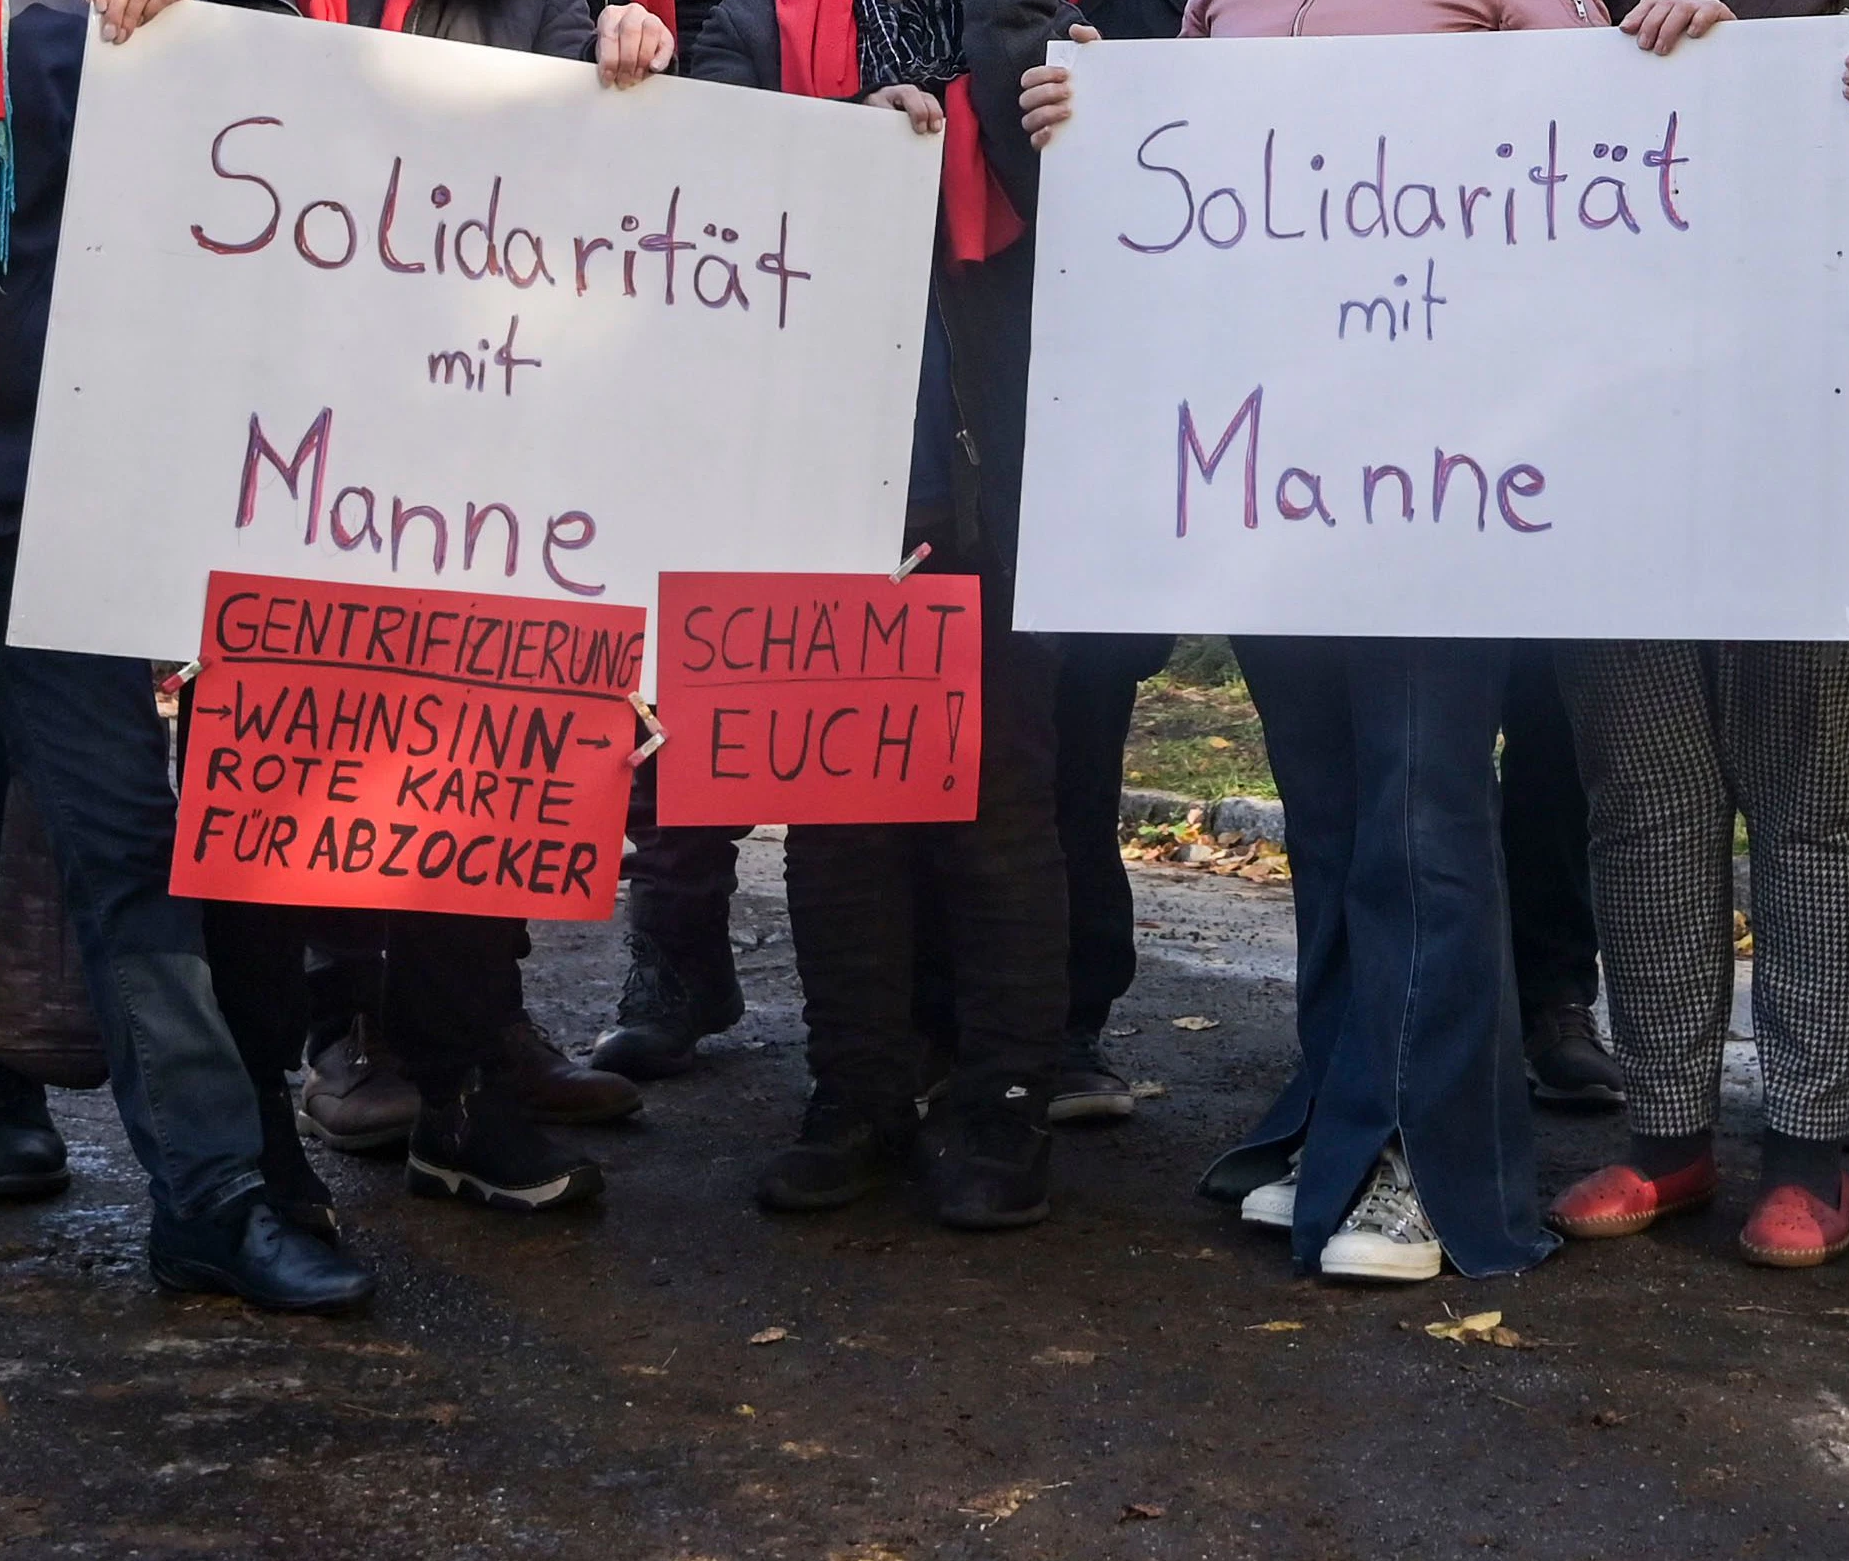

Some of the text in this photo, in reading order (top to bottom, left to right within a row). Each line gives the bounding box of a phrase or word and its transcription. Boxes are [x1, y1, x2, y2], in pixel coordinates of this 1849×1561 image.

[1339, 258, 1448, 342] mit
[428, 315, 542, 396] mit
[235, 407, 606, 596] Manne
[1175, 384, 1554, 538] Manne
[216, 592, 645, 689] GENTRIFIZIERUNG
[683, 600, 965, 673] SCHÄMT
[234, 680, 575, 774] WAHNSINN
[206, 747, 576, 826] ROTE KARTE
[193, 806, 597, 898] FÜR ABZOCKER
